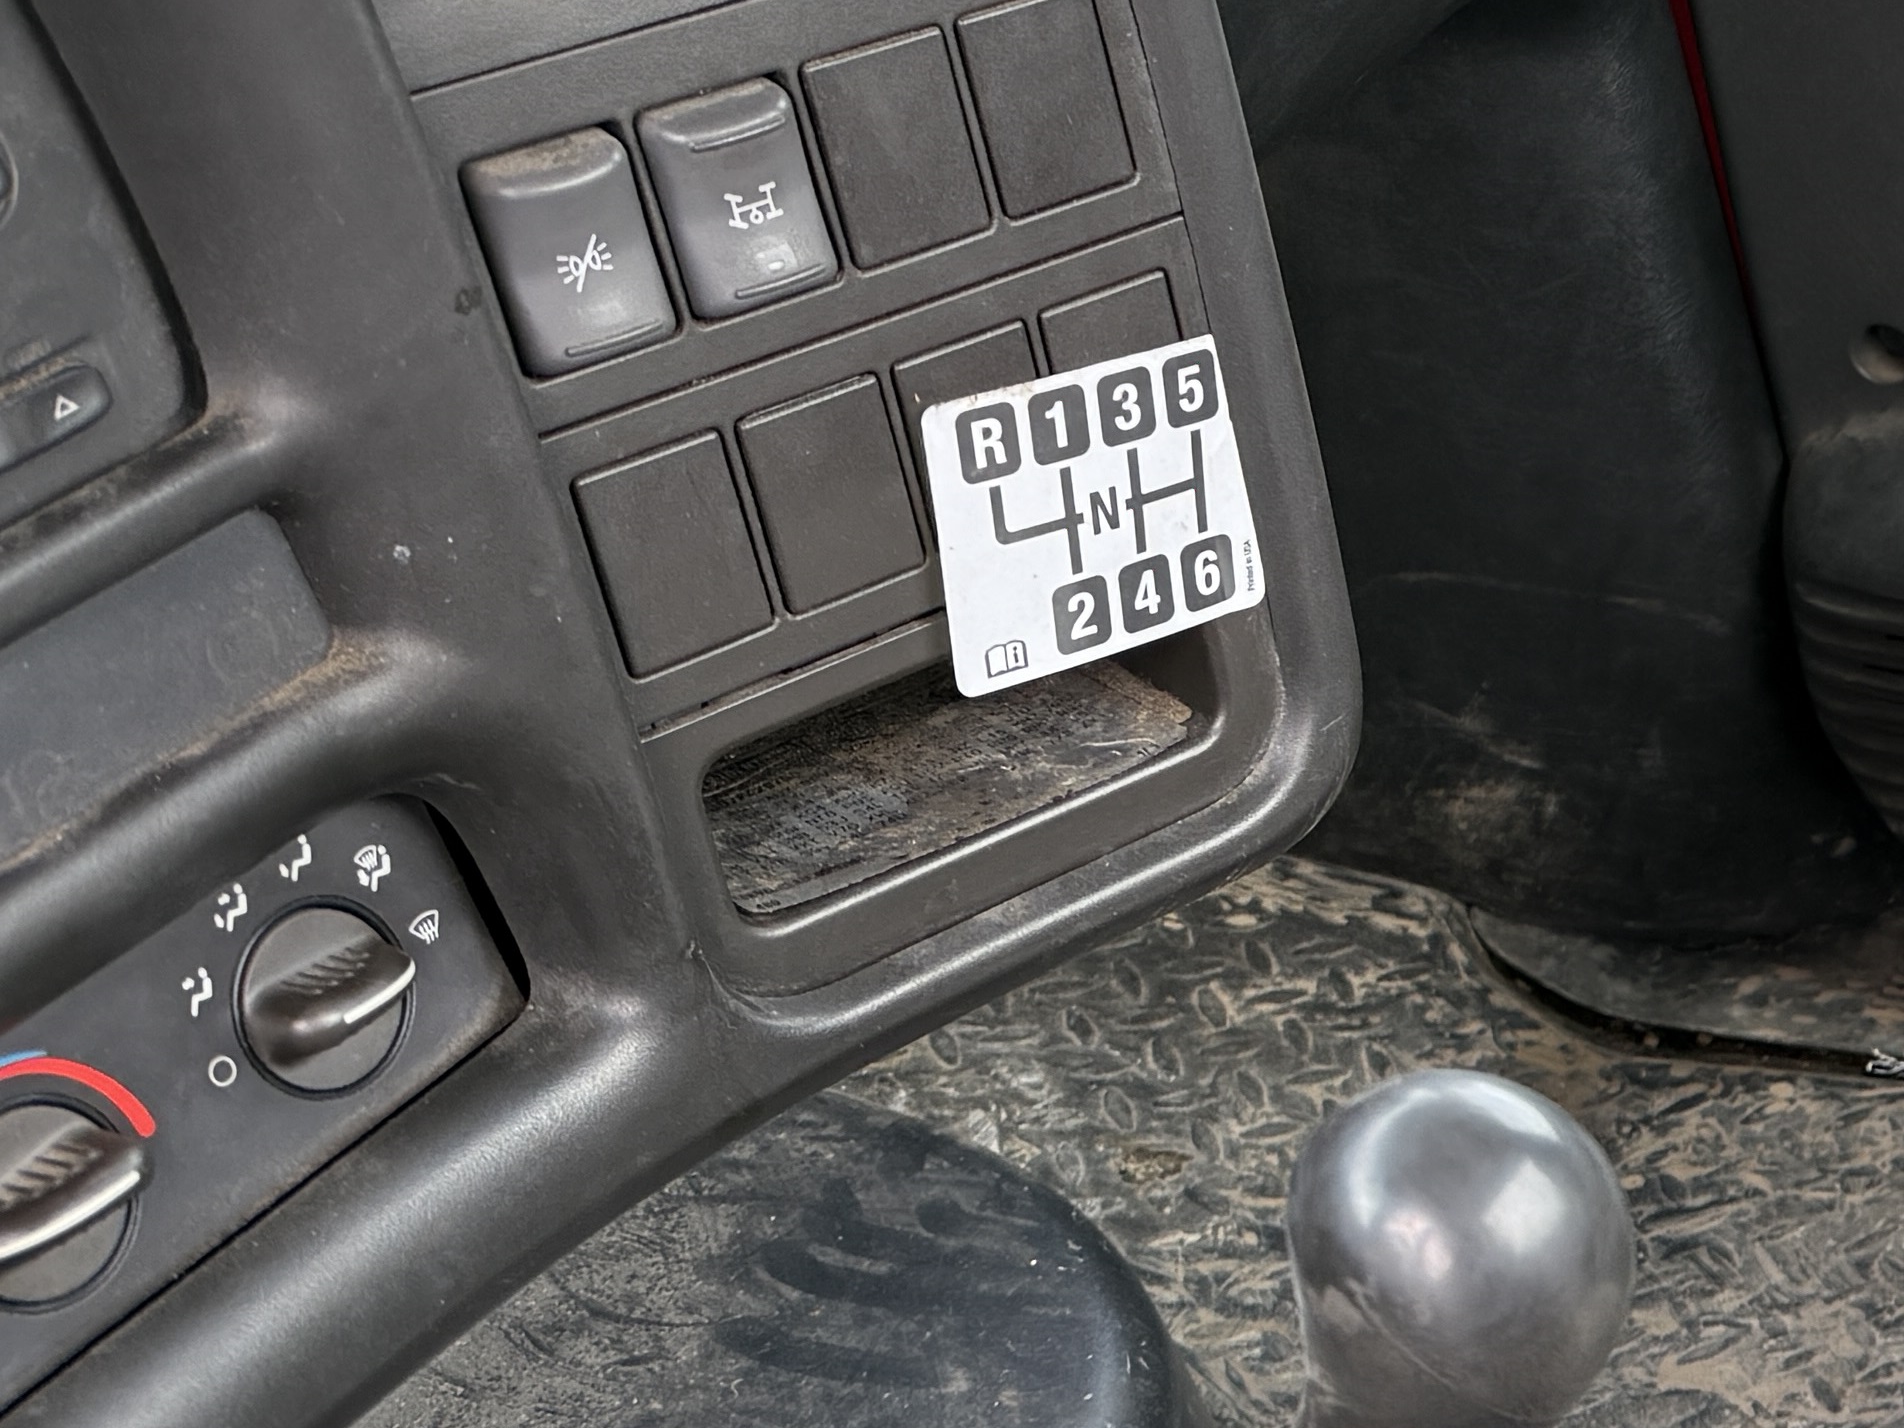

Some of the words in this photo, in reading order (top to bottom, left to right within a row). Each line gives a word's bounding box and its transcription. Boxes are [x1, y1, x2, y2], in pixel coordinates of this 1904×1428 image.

[971, 420, 1010, 470] R
[1045, 400, 1070, 451] 1
[1113, 383, 1141, 433] 3
[1177, 364, 1203, 415] 5
[1088, 485, 1121, 536] N
[1068, 590, 1097, 638] 2
[1133, 568, 1162, 616] 4
[1194, 548, 1220, 597] 6
